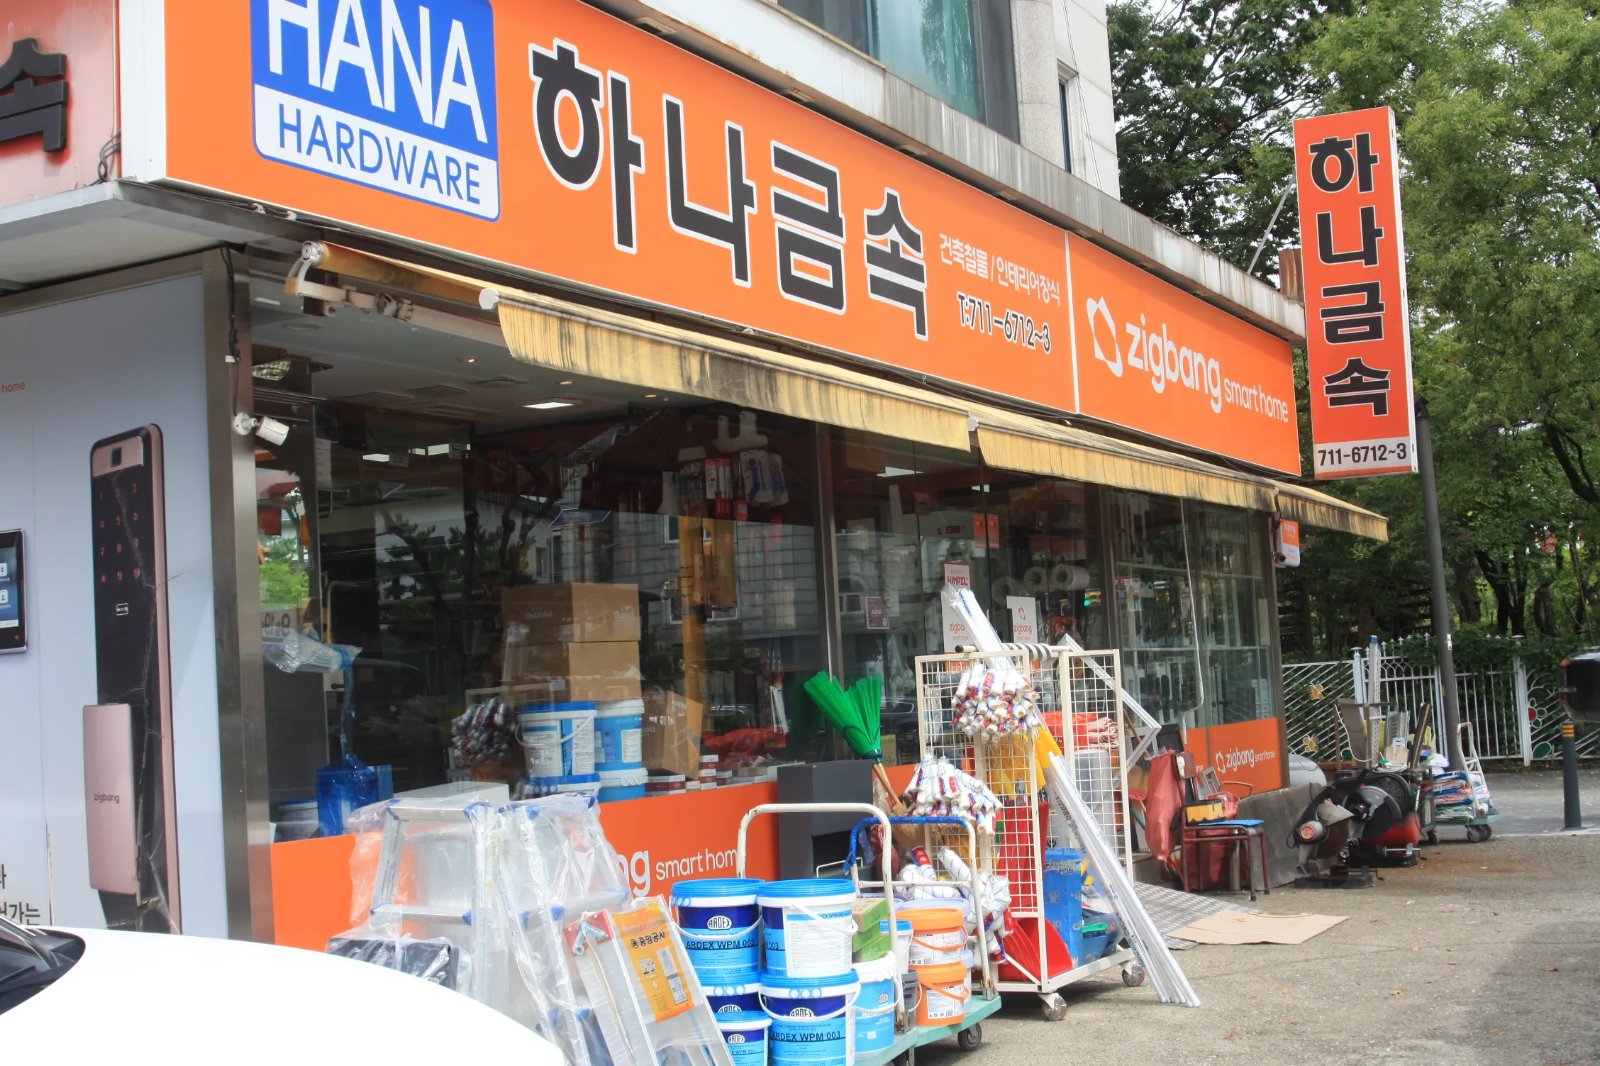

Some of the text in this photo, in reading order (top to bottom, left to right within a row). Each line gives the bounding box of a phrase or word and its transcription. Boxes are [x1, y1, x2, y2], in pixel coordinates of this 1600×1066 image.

[267, 0, 489, 143] HANA
[278, 103, 481, 204] HARDWARE
[528, 37, 928, 341] 하나금속
[939, 233, 989, 280] 건축철물
[996, 256, 1061, 308] 인테리어장식
[1308, 131, 1392, 418] 하나금속
[1125, 313, 1223, 414] zigbang
[1317, 442, 1407, 466] 711-6712~3
[949, 621, 966, 635] zigba
[1225, 747, 1255, 772] zigbang
[93, 791, 120, 804] zigbang
[655, 852, 704, 881] smart
[705, 848, 738, 872] hom
[707, 917, 732, 929] ARDEX
[686, 941, 715, 951] ARDEX
[717, 940, 741, 950] WPM
[771, 1030, 841, 1042] ARDEX WPM 003
